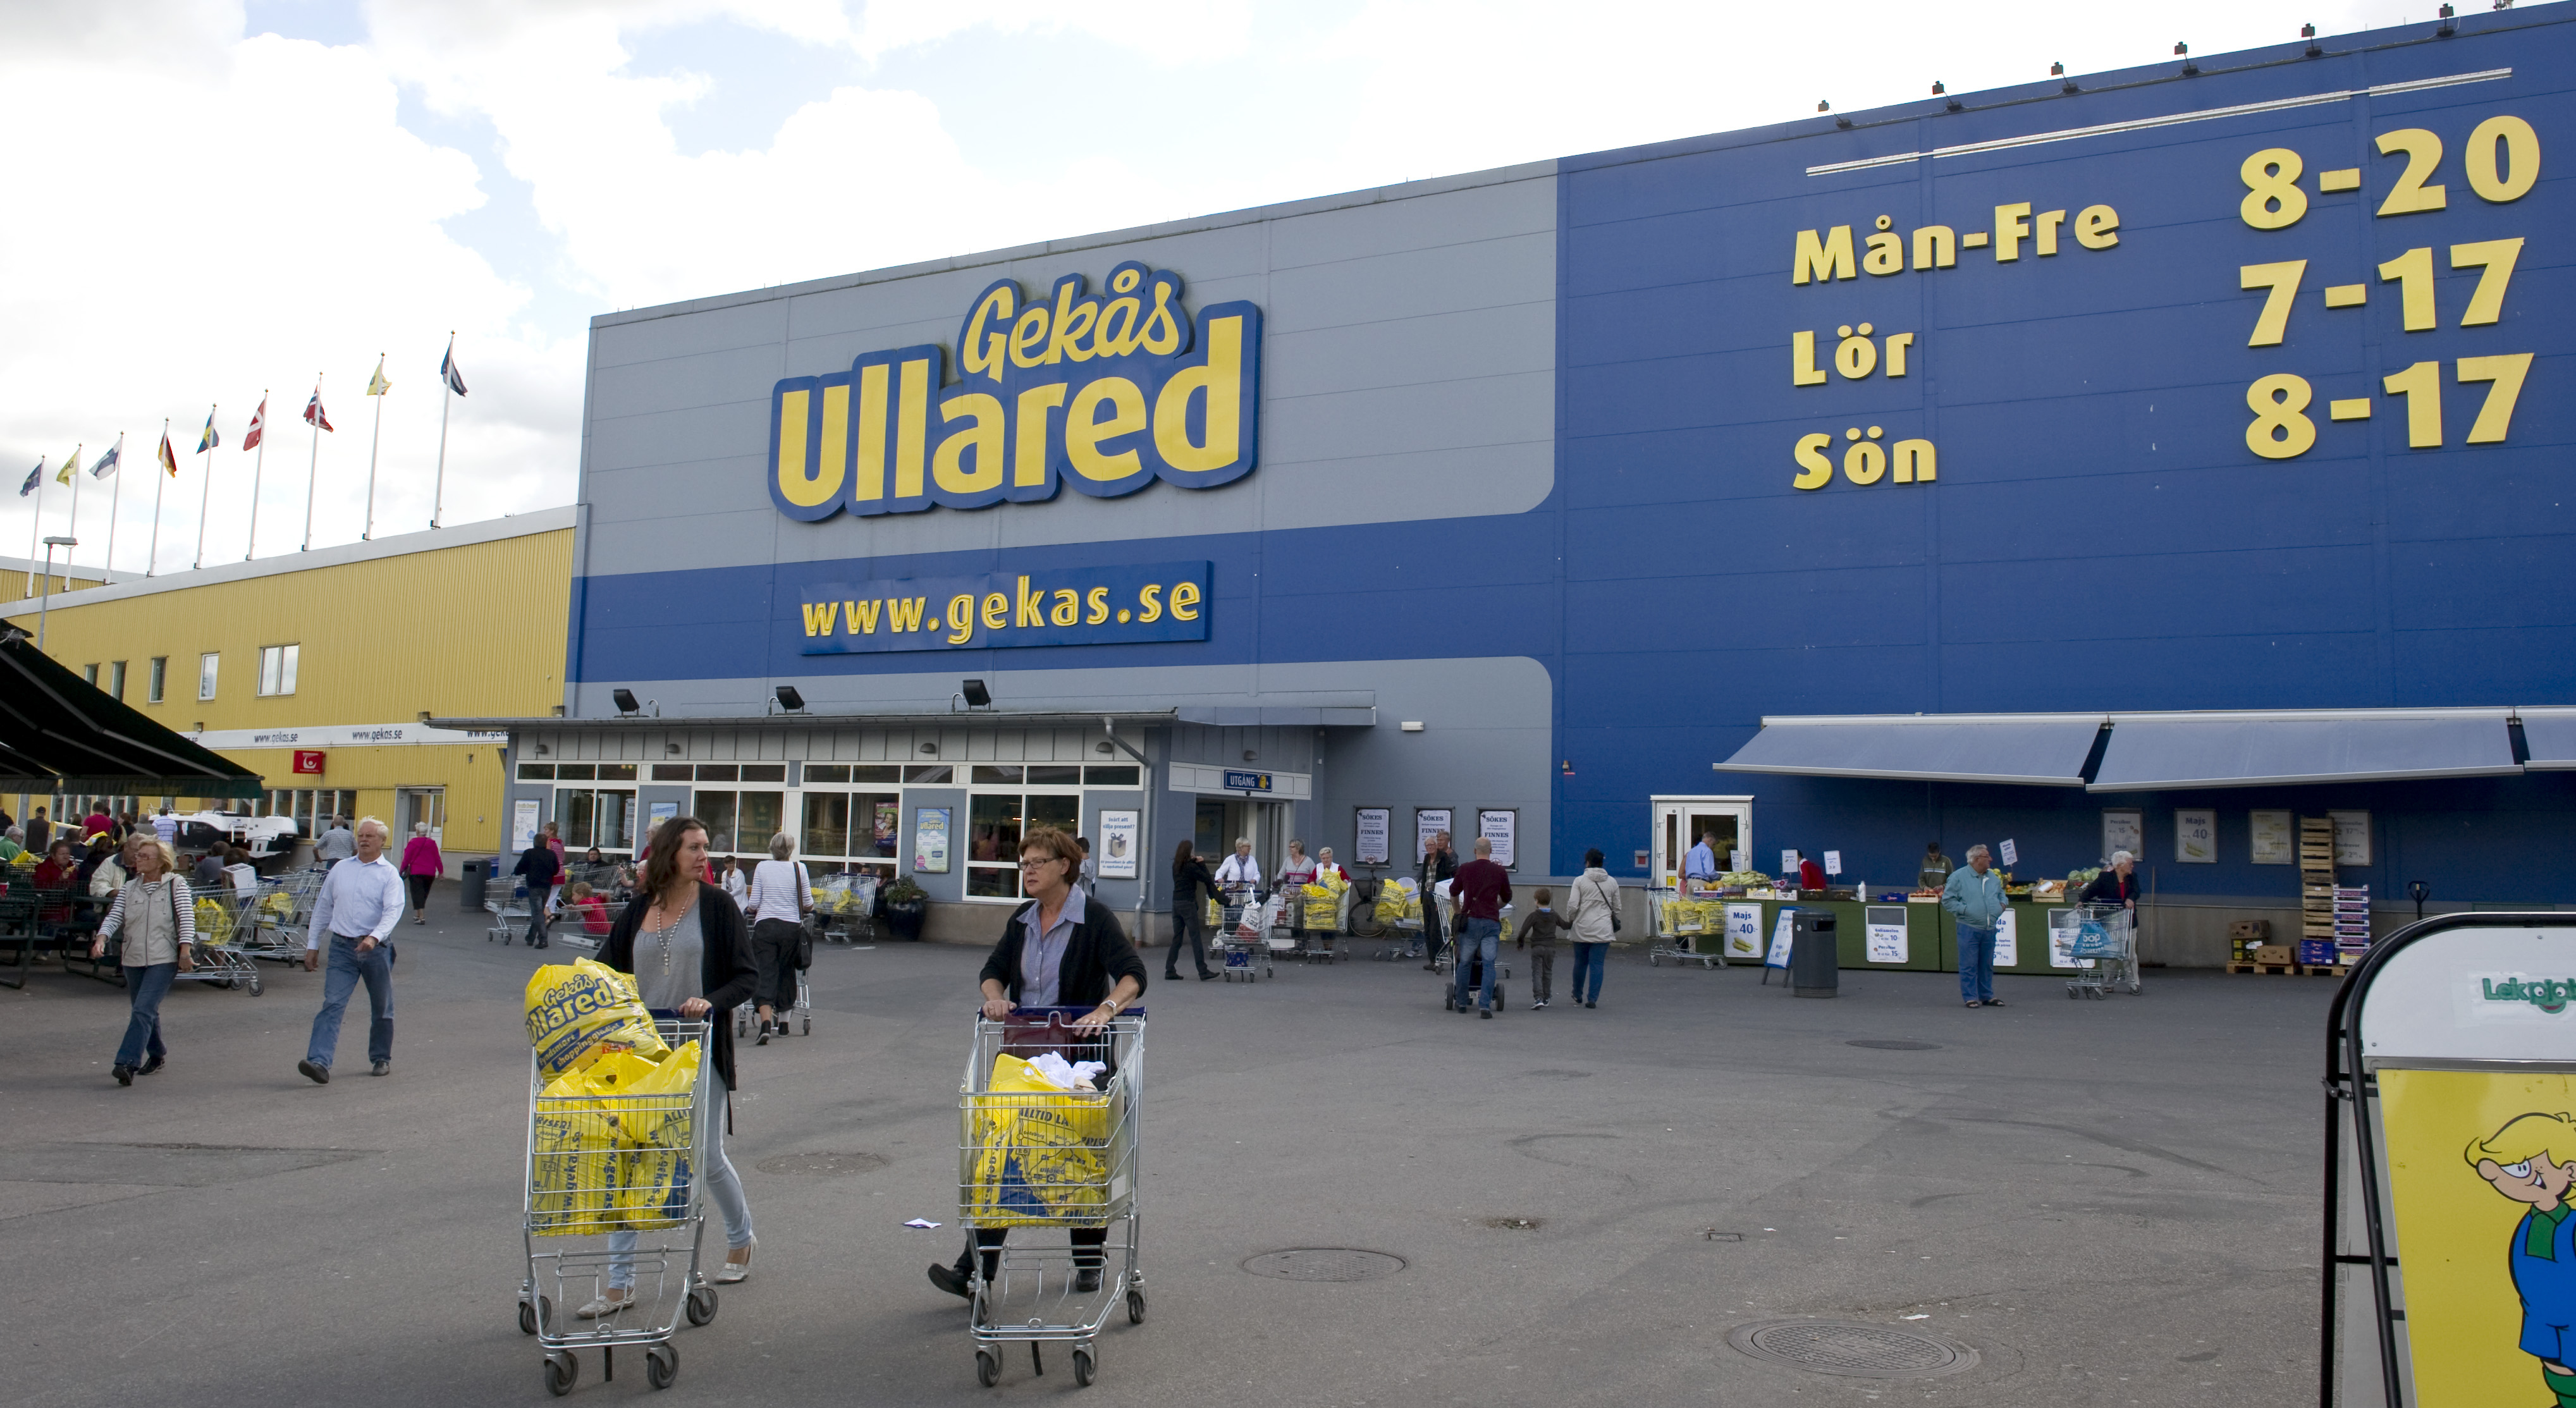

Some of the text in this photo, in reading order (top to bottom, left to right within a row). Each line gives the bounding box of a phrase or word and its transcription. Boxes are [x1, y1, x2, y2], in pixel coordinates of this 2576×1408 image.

[1793, 116, 2541, 285] Mån-Fre 8-20
[962, 269, 1180, 384] Gekås
[1793, 237, 2524, 386] Lör 7-17
[1793, 353, 2534, 490] Sön 8-17
[801, 574, 1201, 644] www.gekas.se
[254, 731, 298, 745] www.gekas.se
[352, 728, 403, 743] www.gekas.se
[1230, 774, 1255, 787] UTGÅNG
[2185, 817, 2205, 826] Majs
[1733, 911, 1751, 921] Majs
[543, 974, 596, 1008] Gekås
[539, 1033, 576, 1067] fyndsmart
